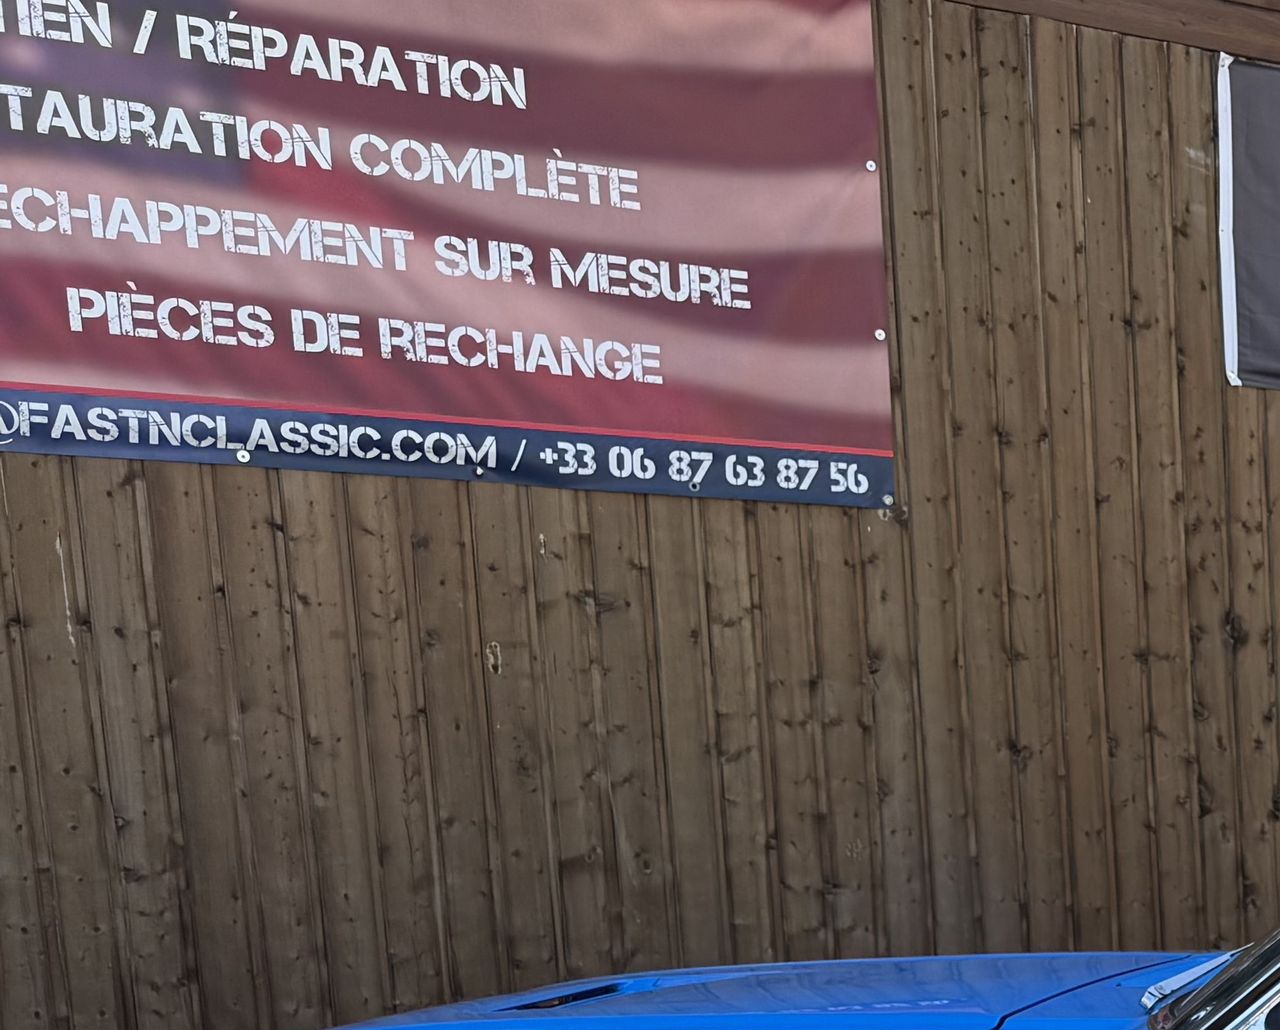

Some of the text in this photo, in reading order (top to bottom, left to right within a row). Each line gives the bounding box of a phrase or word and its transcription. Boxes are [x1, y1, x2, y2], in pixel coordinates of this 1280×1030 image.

[0, 0, 527, 110] IEN / RÉPARATION
[0, 84, 641, 212] TAURATION COMPLÈTE
[434, 235, 536, 286] SUR
[549, 248, 752, 310] MESURE
[66, 281, 664, 385] PIÈCES DE RECHANGE
[511, 439, 527, 471] /
[539, 441, 597, 475] +33
[608, 446, 656, 480] 06
[668, 450, 713, 484] 87
[725, 454, 765, 487] 63
[776, 458, 819, 490] 87
[830, 462, 869, 494] 56
